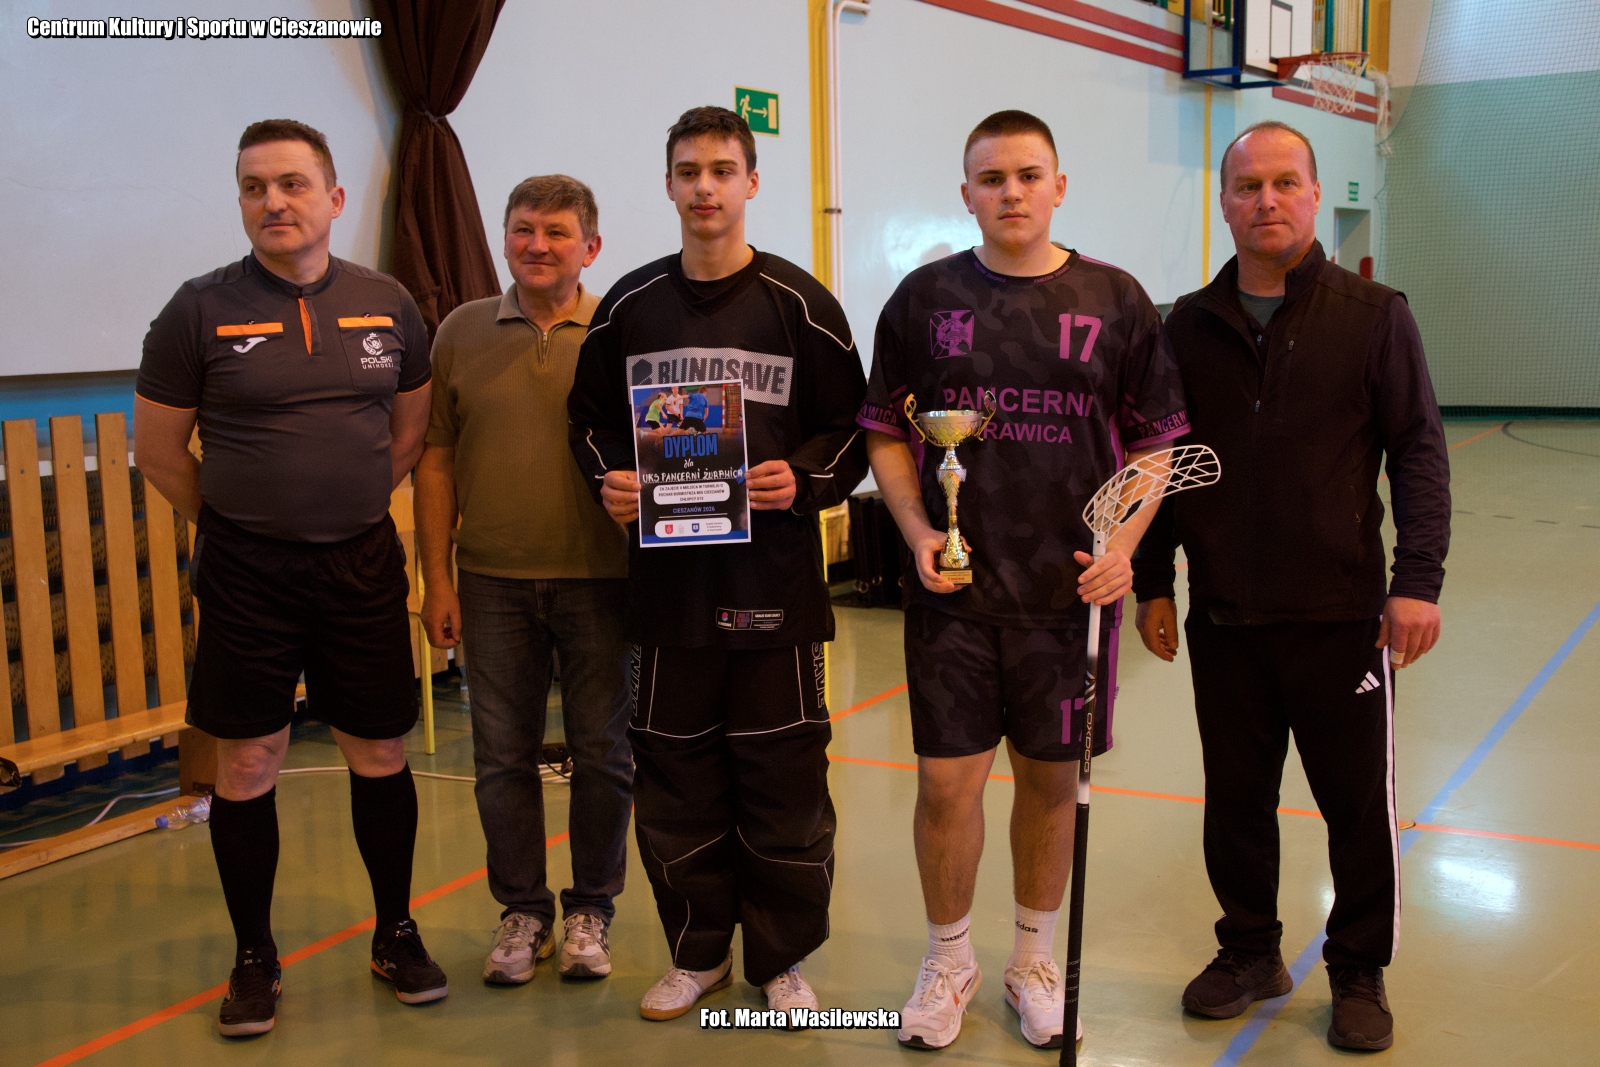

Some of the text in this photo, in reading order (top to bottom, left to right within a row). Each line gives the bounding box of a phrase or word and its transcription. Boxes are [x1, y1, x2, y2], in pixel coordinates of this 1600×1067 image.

[1058, 313, 1102, 363] 17
[360, 355, 393, 364] POLSKI
[657, 356, 787, 395] BLINDSAVE
[860, 402, 898, 426] AWICA
[943, 386, 1094, 418] PANCERNI
[983, 421, 1073, 444] RAWICA
[1137, 409, 1187, 439] PANCERN
[663, 432, 718, 459] DYPLOM
[683, 458, 694, 469] dla
[642, 473, 660, 483] UKS
[672, 506, 702, 514] CIESZANÓW
[1083, 712, 1093, 773] OXDOG
